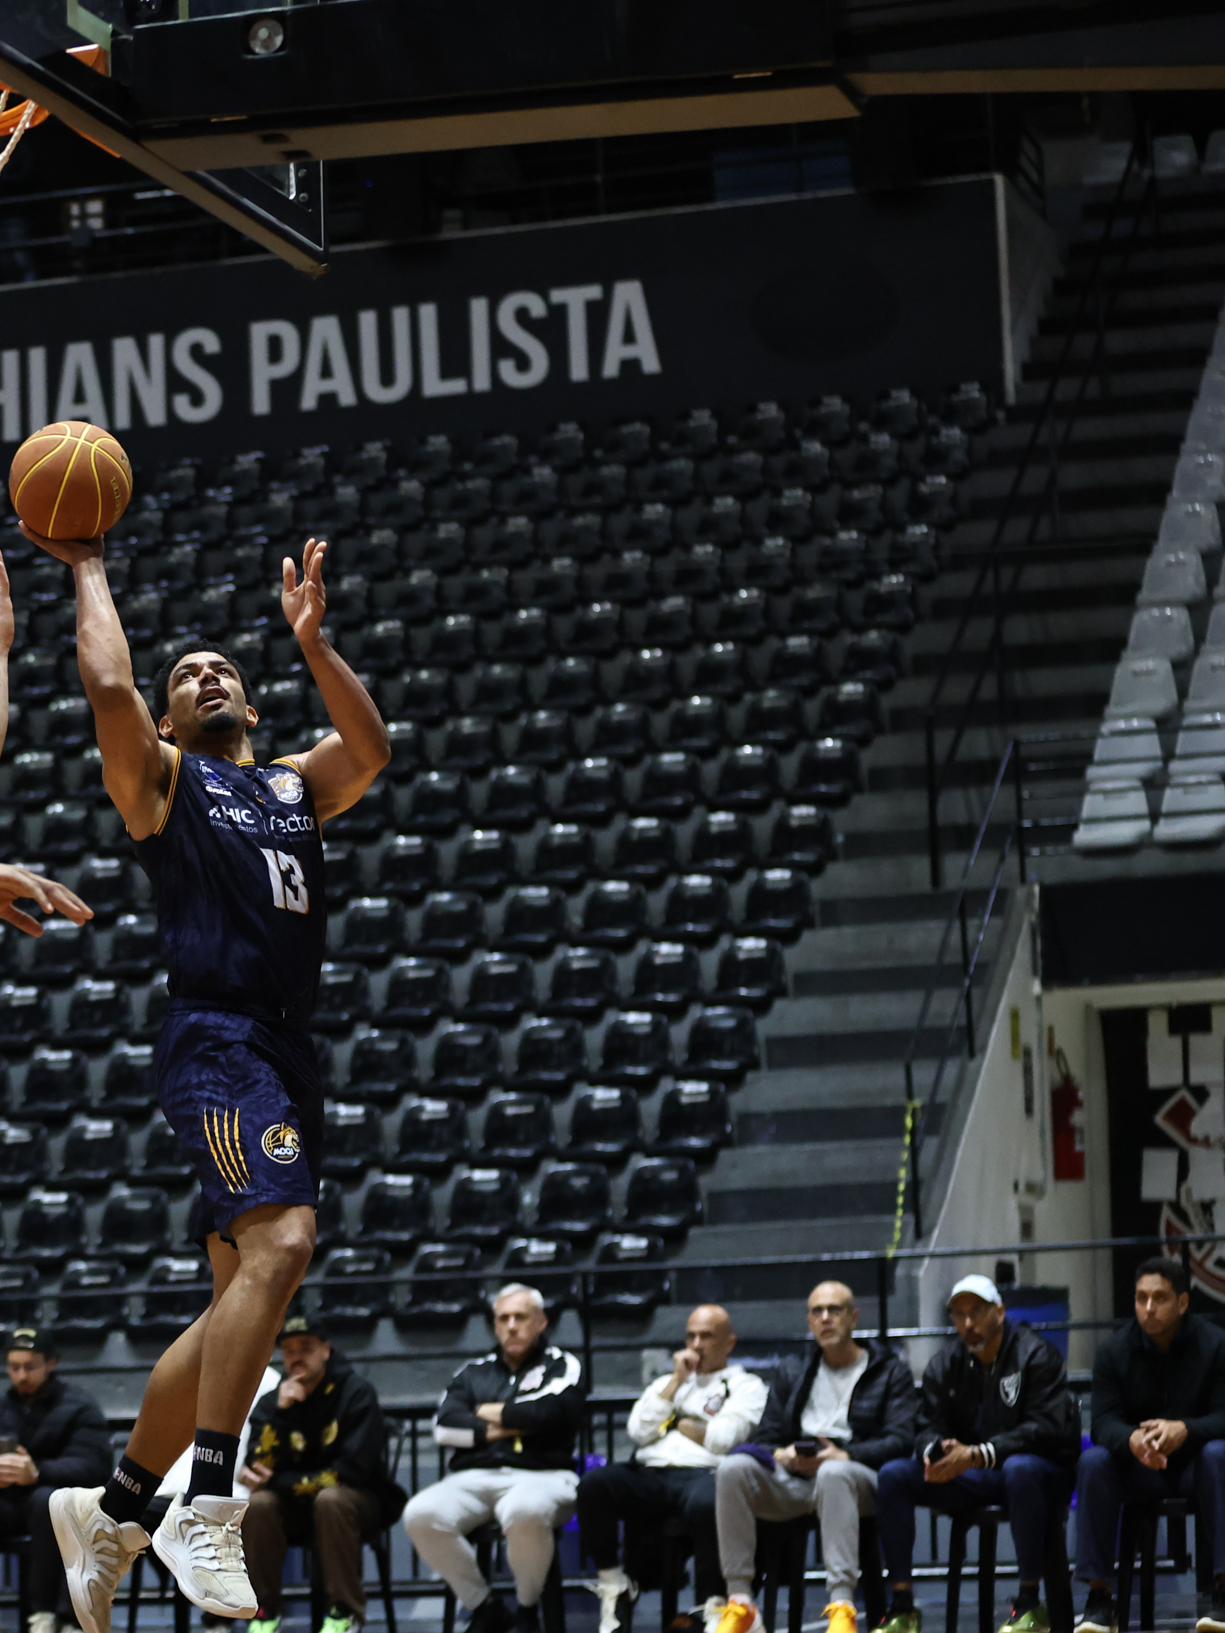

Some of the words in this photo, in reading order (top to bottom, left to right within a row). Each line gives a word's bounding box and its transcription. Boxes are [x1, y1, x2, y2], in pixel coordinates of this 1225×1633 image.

[250, 280, 662, 415] PAULISTA
[260, 848, 310, 915] 13
[197, 1446, 224, 1466] NBA
[118, 1471, 142, 1495] NBA
